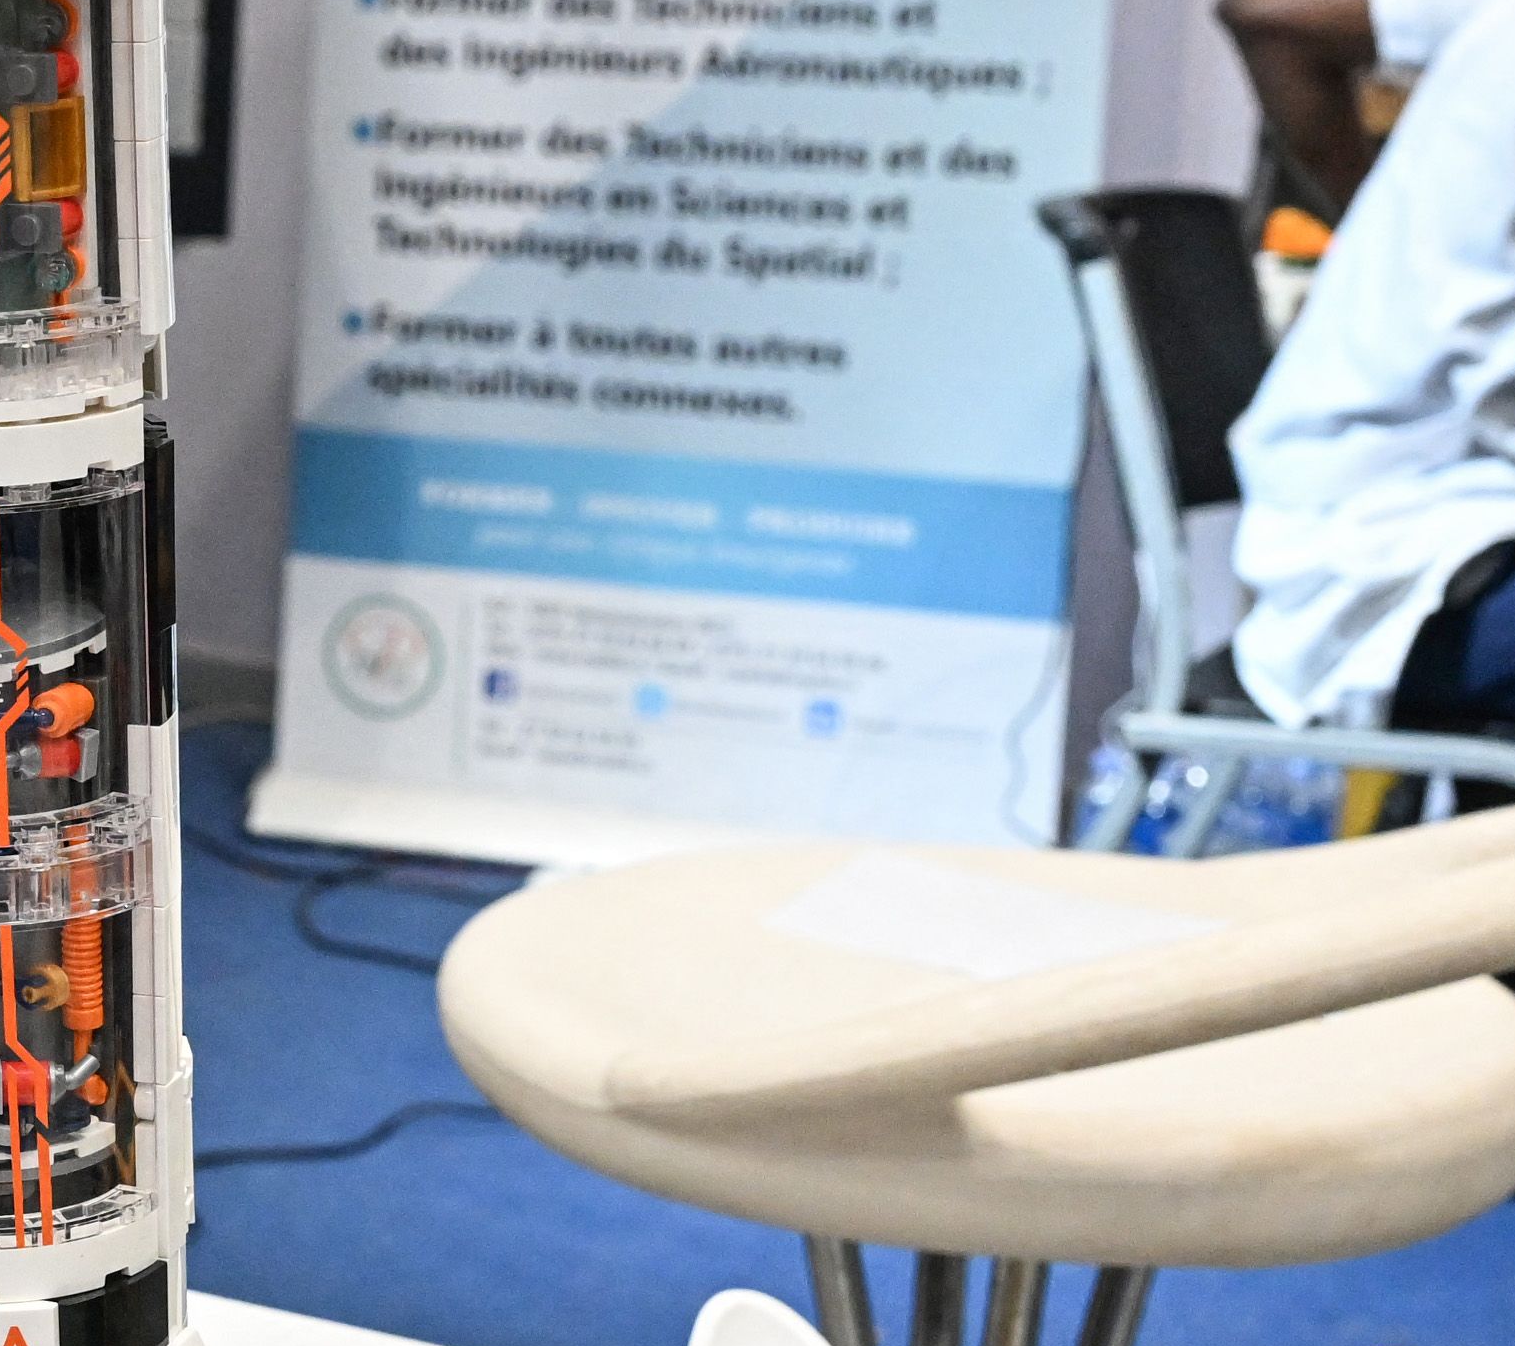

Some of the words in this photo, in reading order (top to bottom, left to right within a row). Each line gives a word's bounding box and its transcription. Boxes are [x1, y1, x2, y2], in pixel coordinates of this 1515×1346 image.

[380, 32, 448, 70] des
[375, 111, 524, 152] Former
[539, 118, 608, 155] des
[625, 121, 869, 171] Techniciens
[884, 135, 927, 172] et
[942, 141, 1016, 179] des
[607, 185, 656, 214] en
[670, 177, 850, 224] Sciences
[866, 193, 909, 228] et
[374, 215, 642, 276] Technologies
[655, 236, 712, 272] du
[723, 236, 873, 287] Spatial
[372, 304, 516, 346] Former
[567, 319, 698, 357] toutes
[712, 329, 846, 369] autres
